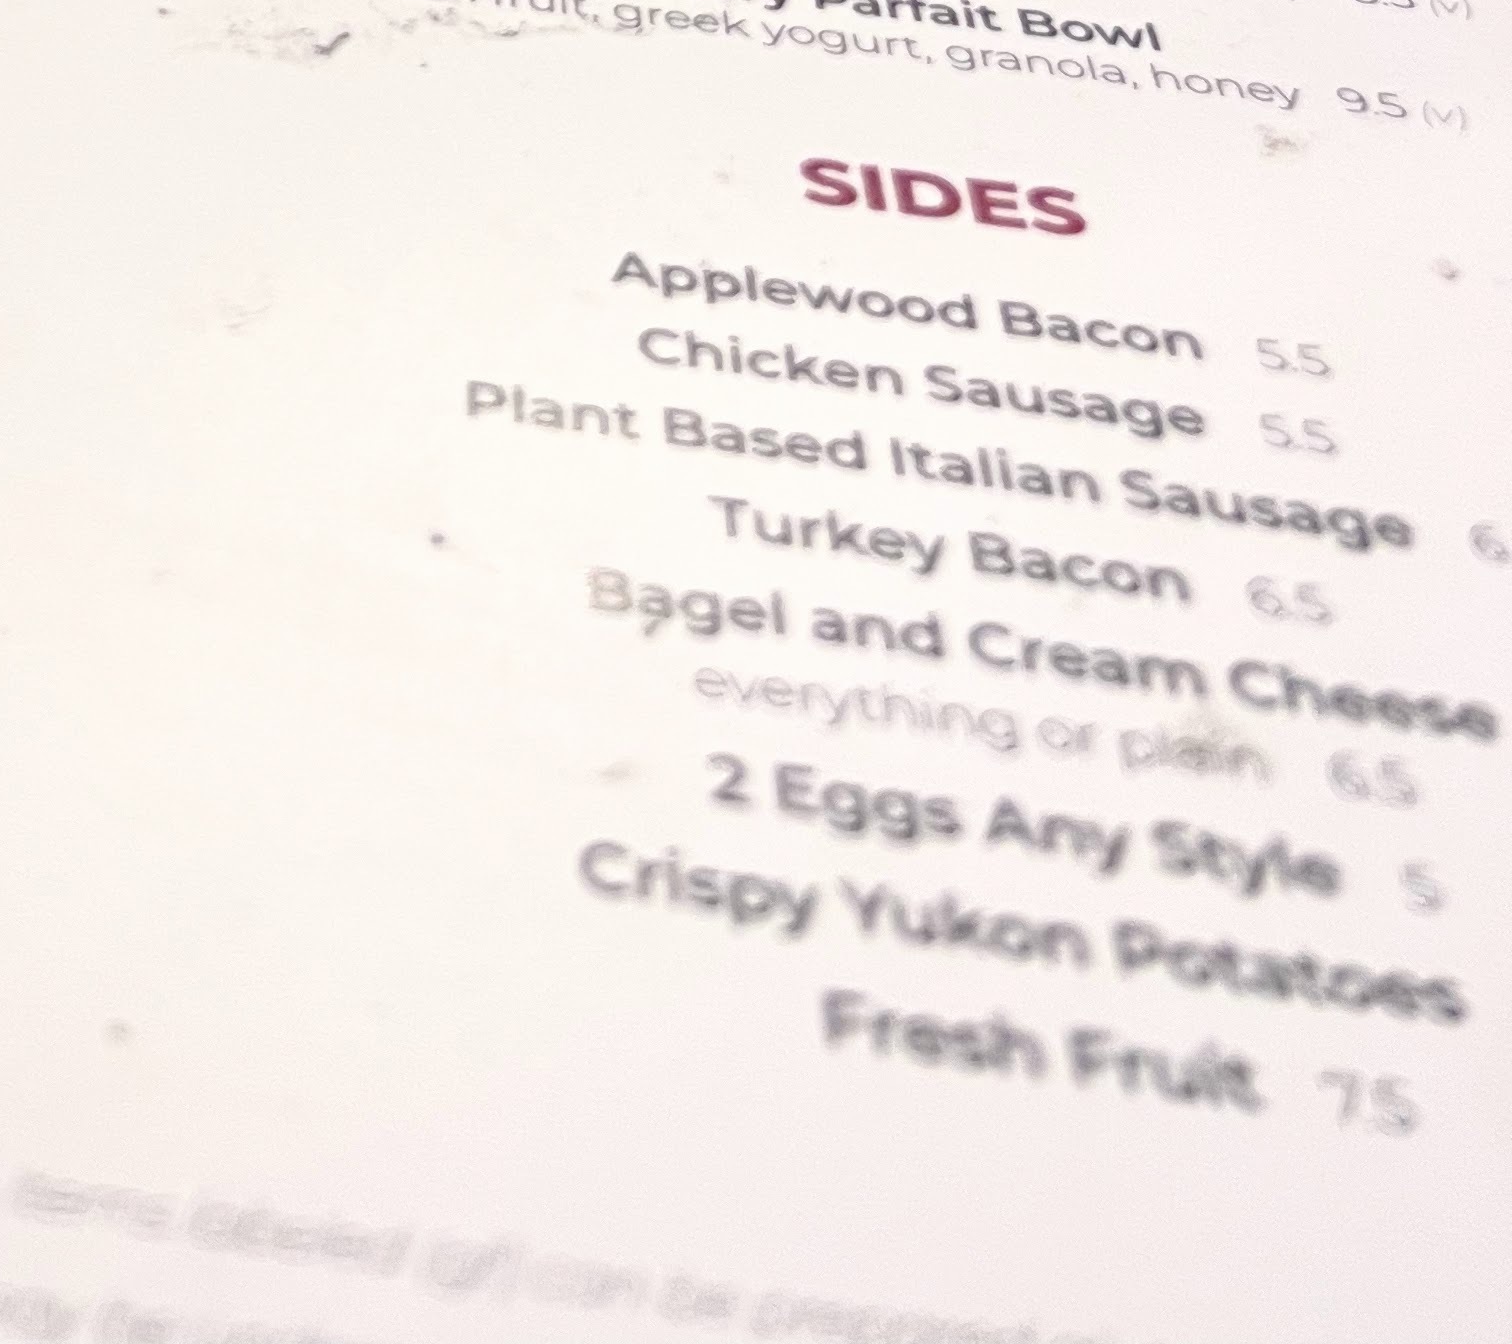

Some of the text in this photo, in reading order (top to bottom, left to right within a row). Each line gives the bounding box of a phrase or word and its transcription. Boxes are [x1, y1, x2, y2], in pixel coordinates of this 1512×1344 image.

[1017, 8, 1162, 52] Bowl
[798, 155, 1089, 236] SIDES
[610, 251, 1332, 377] Applewood Bacon 5.5
[637, 327, 1338, 456] Chicken Sausage 5.5
[707, 495, 946, 579] Turkey
[967, 530, 1194, 606] Bacon
